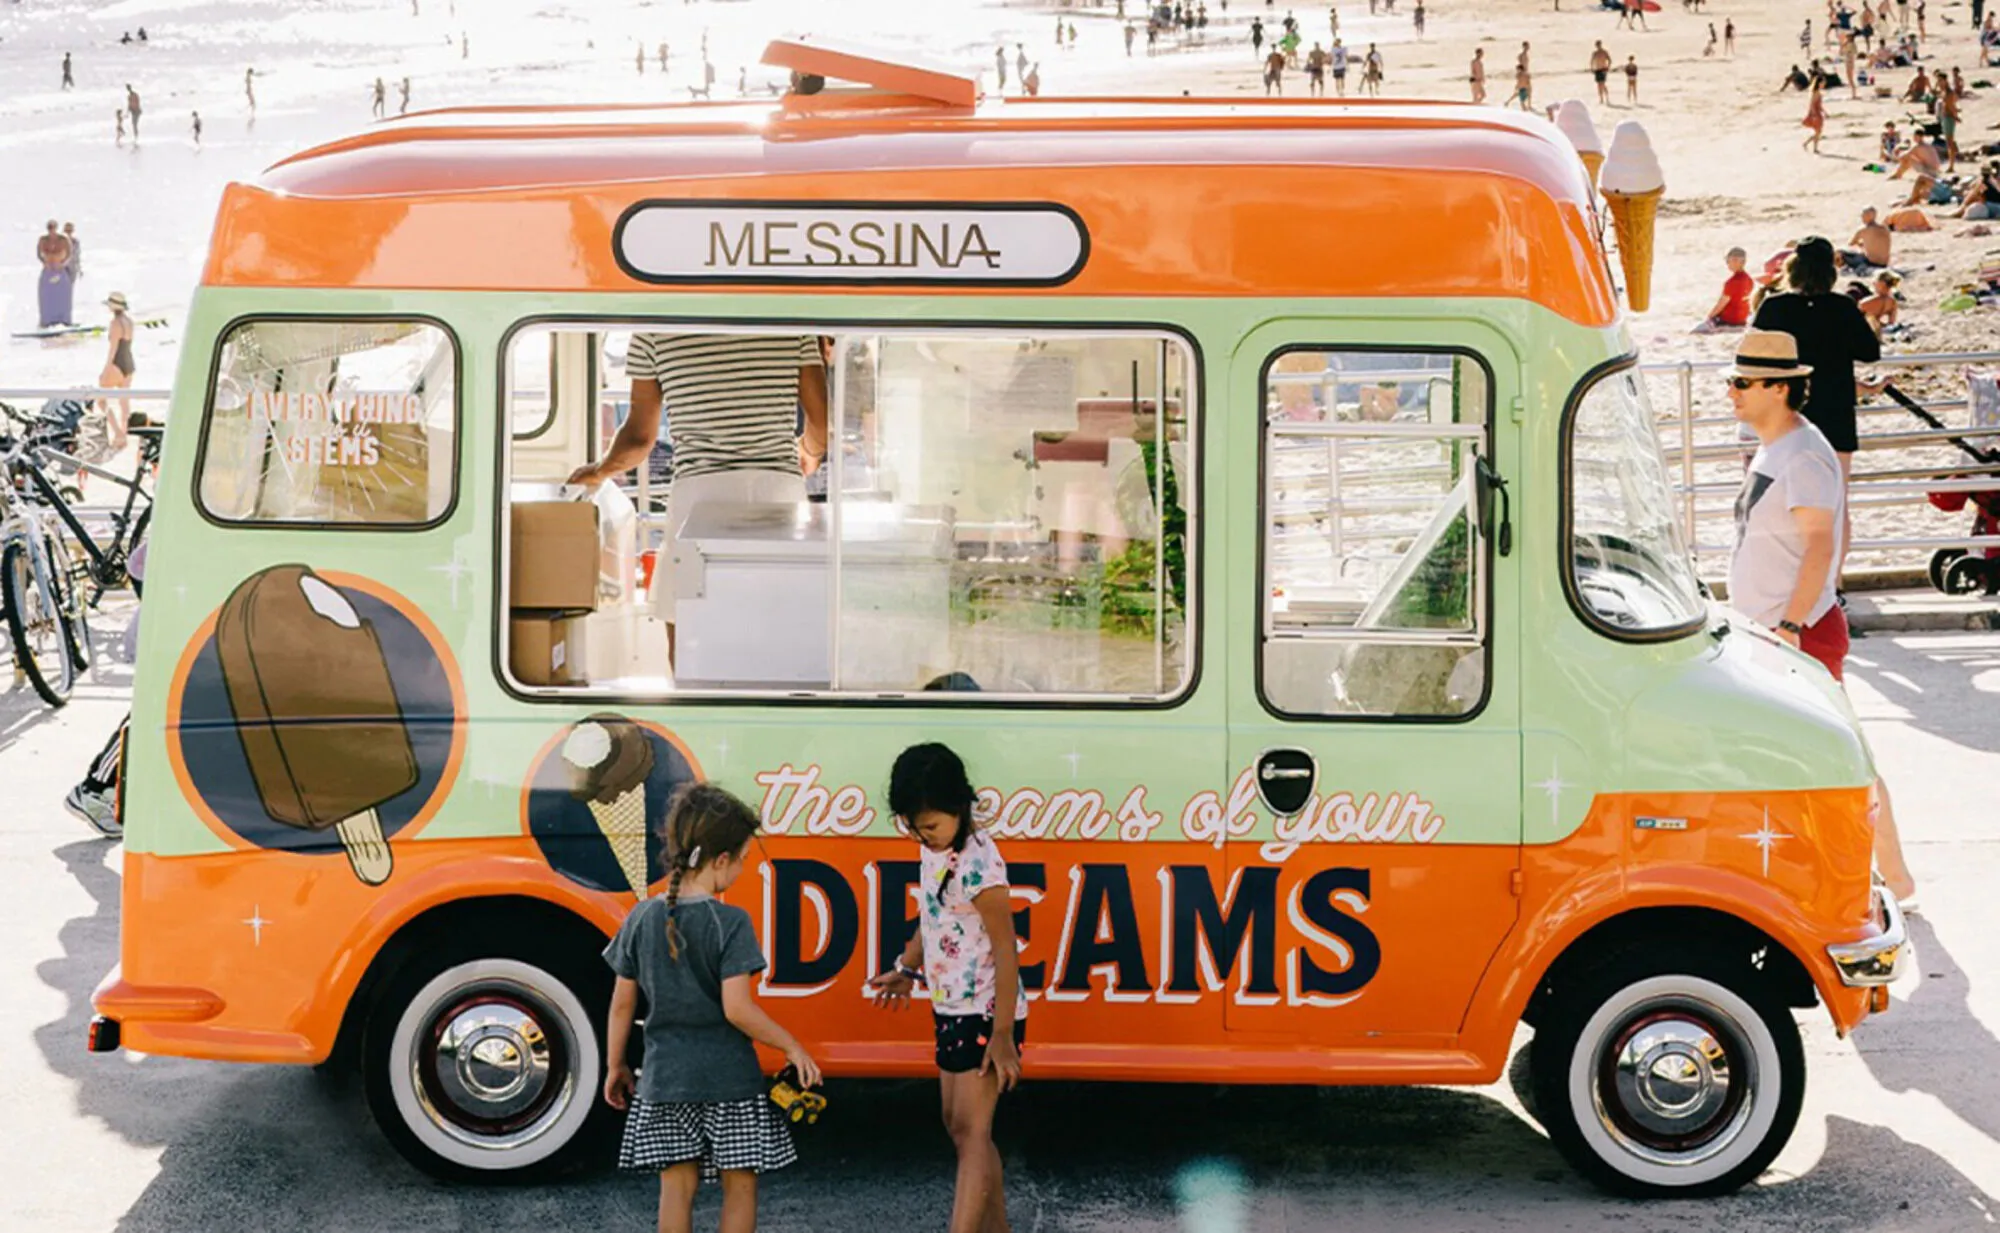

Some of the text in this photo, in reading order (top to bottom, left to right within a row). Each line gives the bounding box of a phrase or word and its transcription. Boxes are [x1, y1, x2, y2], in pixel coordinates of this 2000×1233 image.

[704, 221, 1001, 268] MESSINA
[246, 391, 422, 423] EVERYTHING
[287, 435, 381, 466] SEEMS
[755, 762, 1445, 862] the eams of your
